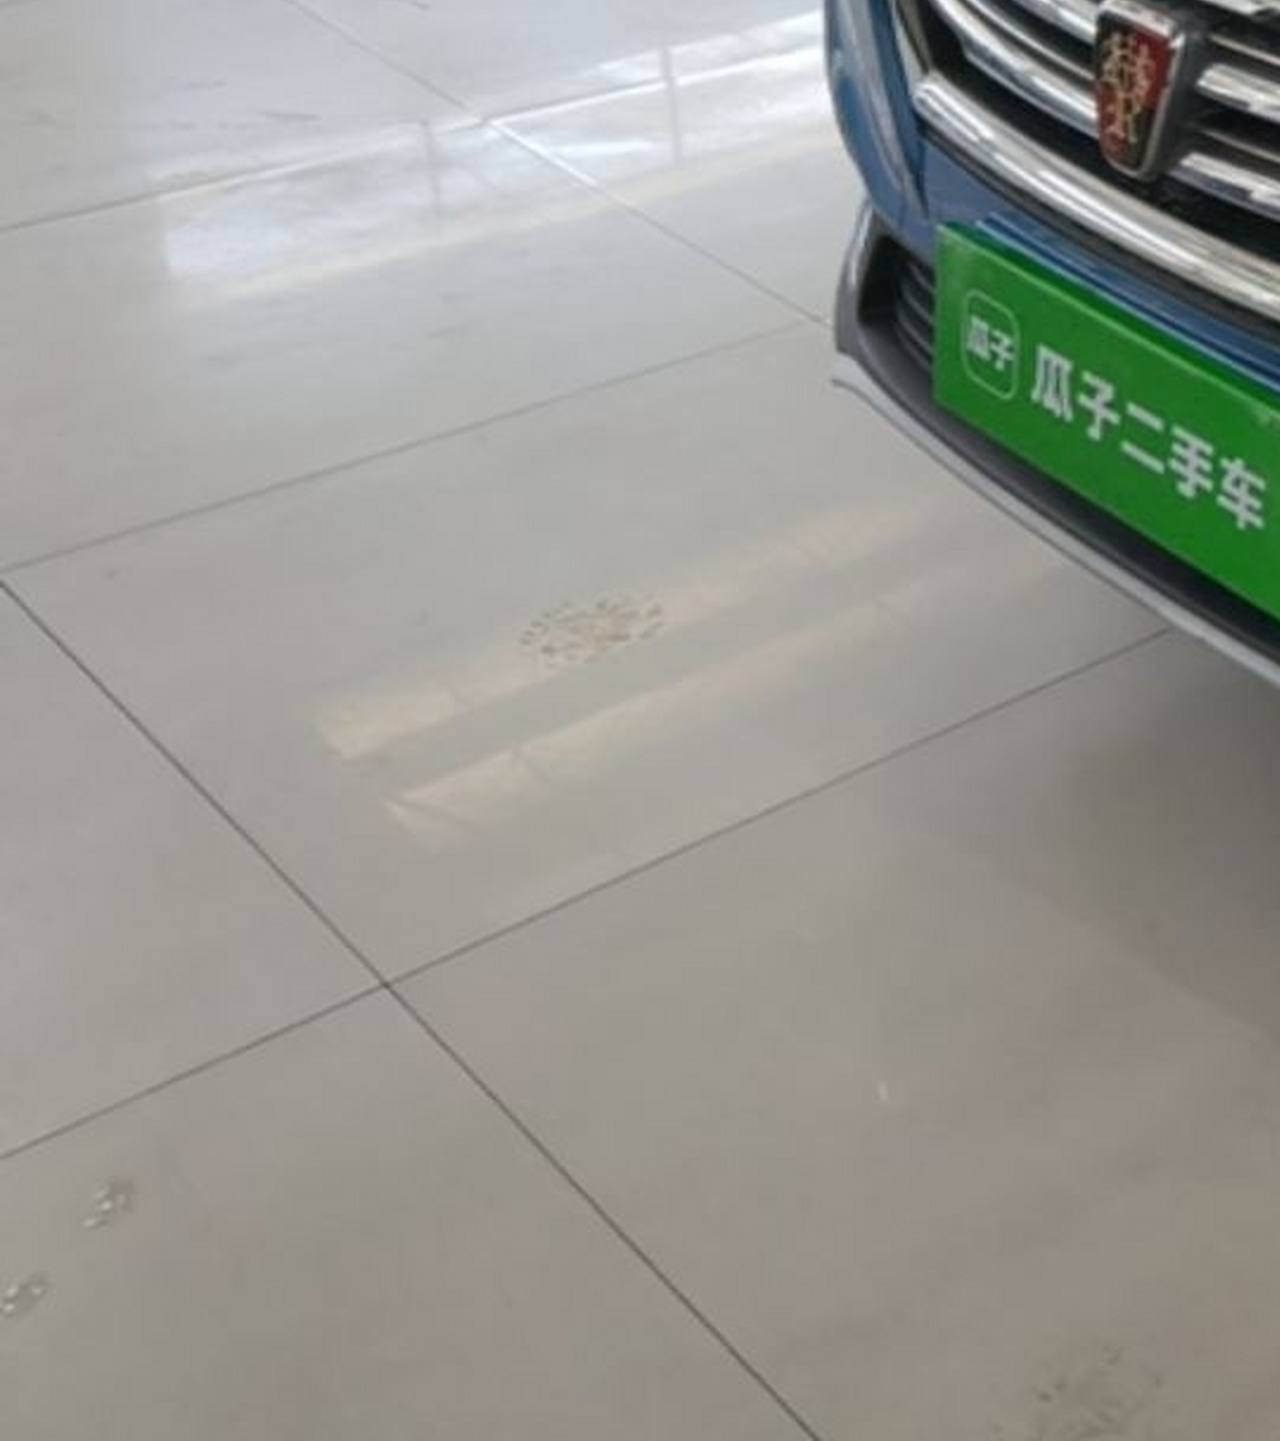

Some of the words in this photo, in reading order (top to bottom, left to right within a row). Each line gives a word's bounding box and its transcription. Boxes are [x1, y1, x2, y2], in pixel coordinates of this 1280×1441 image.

[1031, 343, 1267, 530] 瓜子二手车
